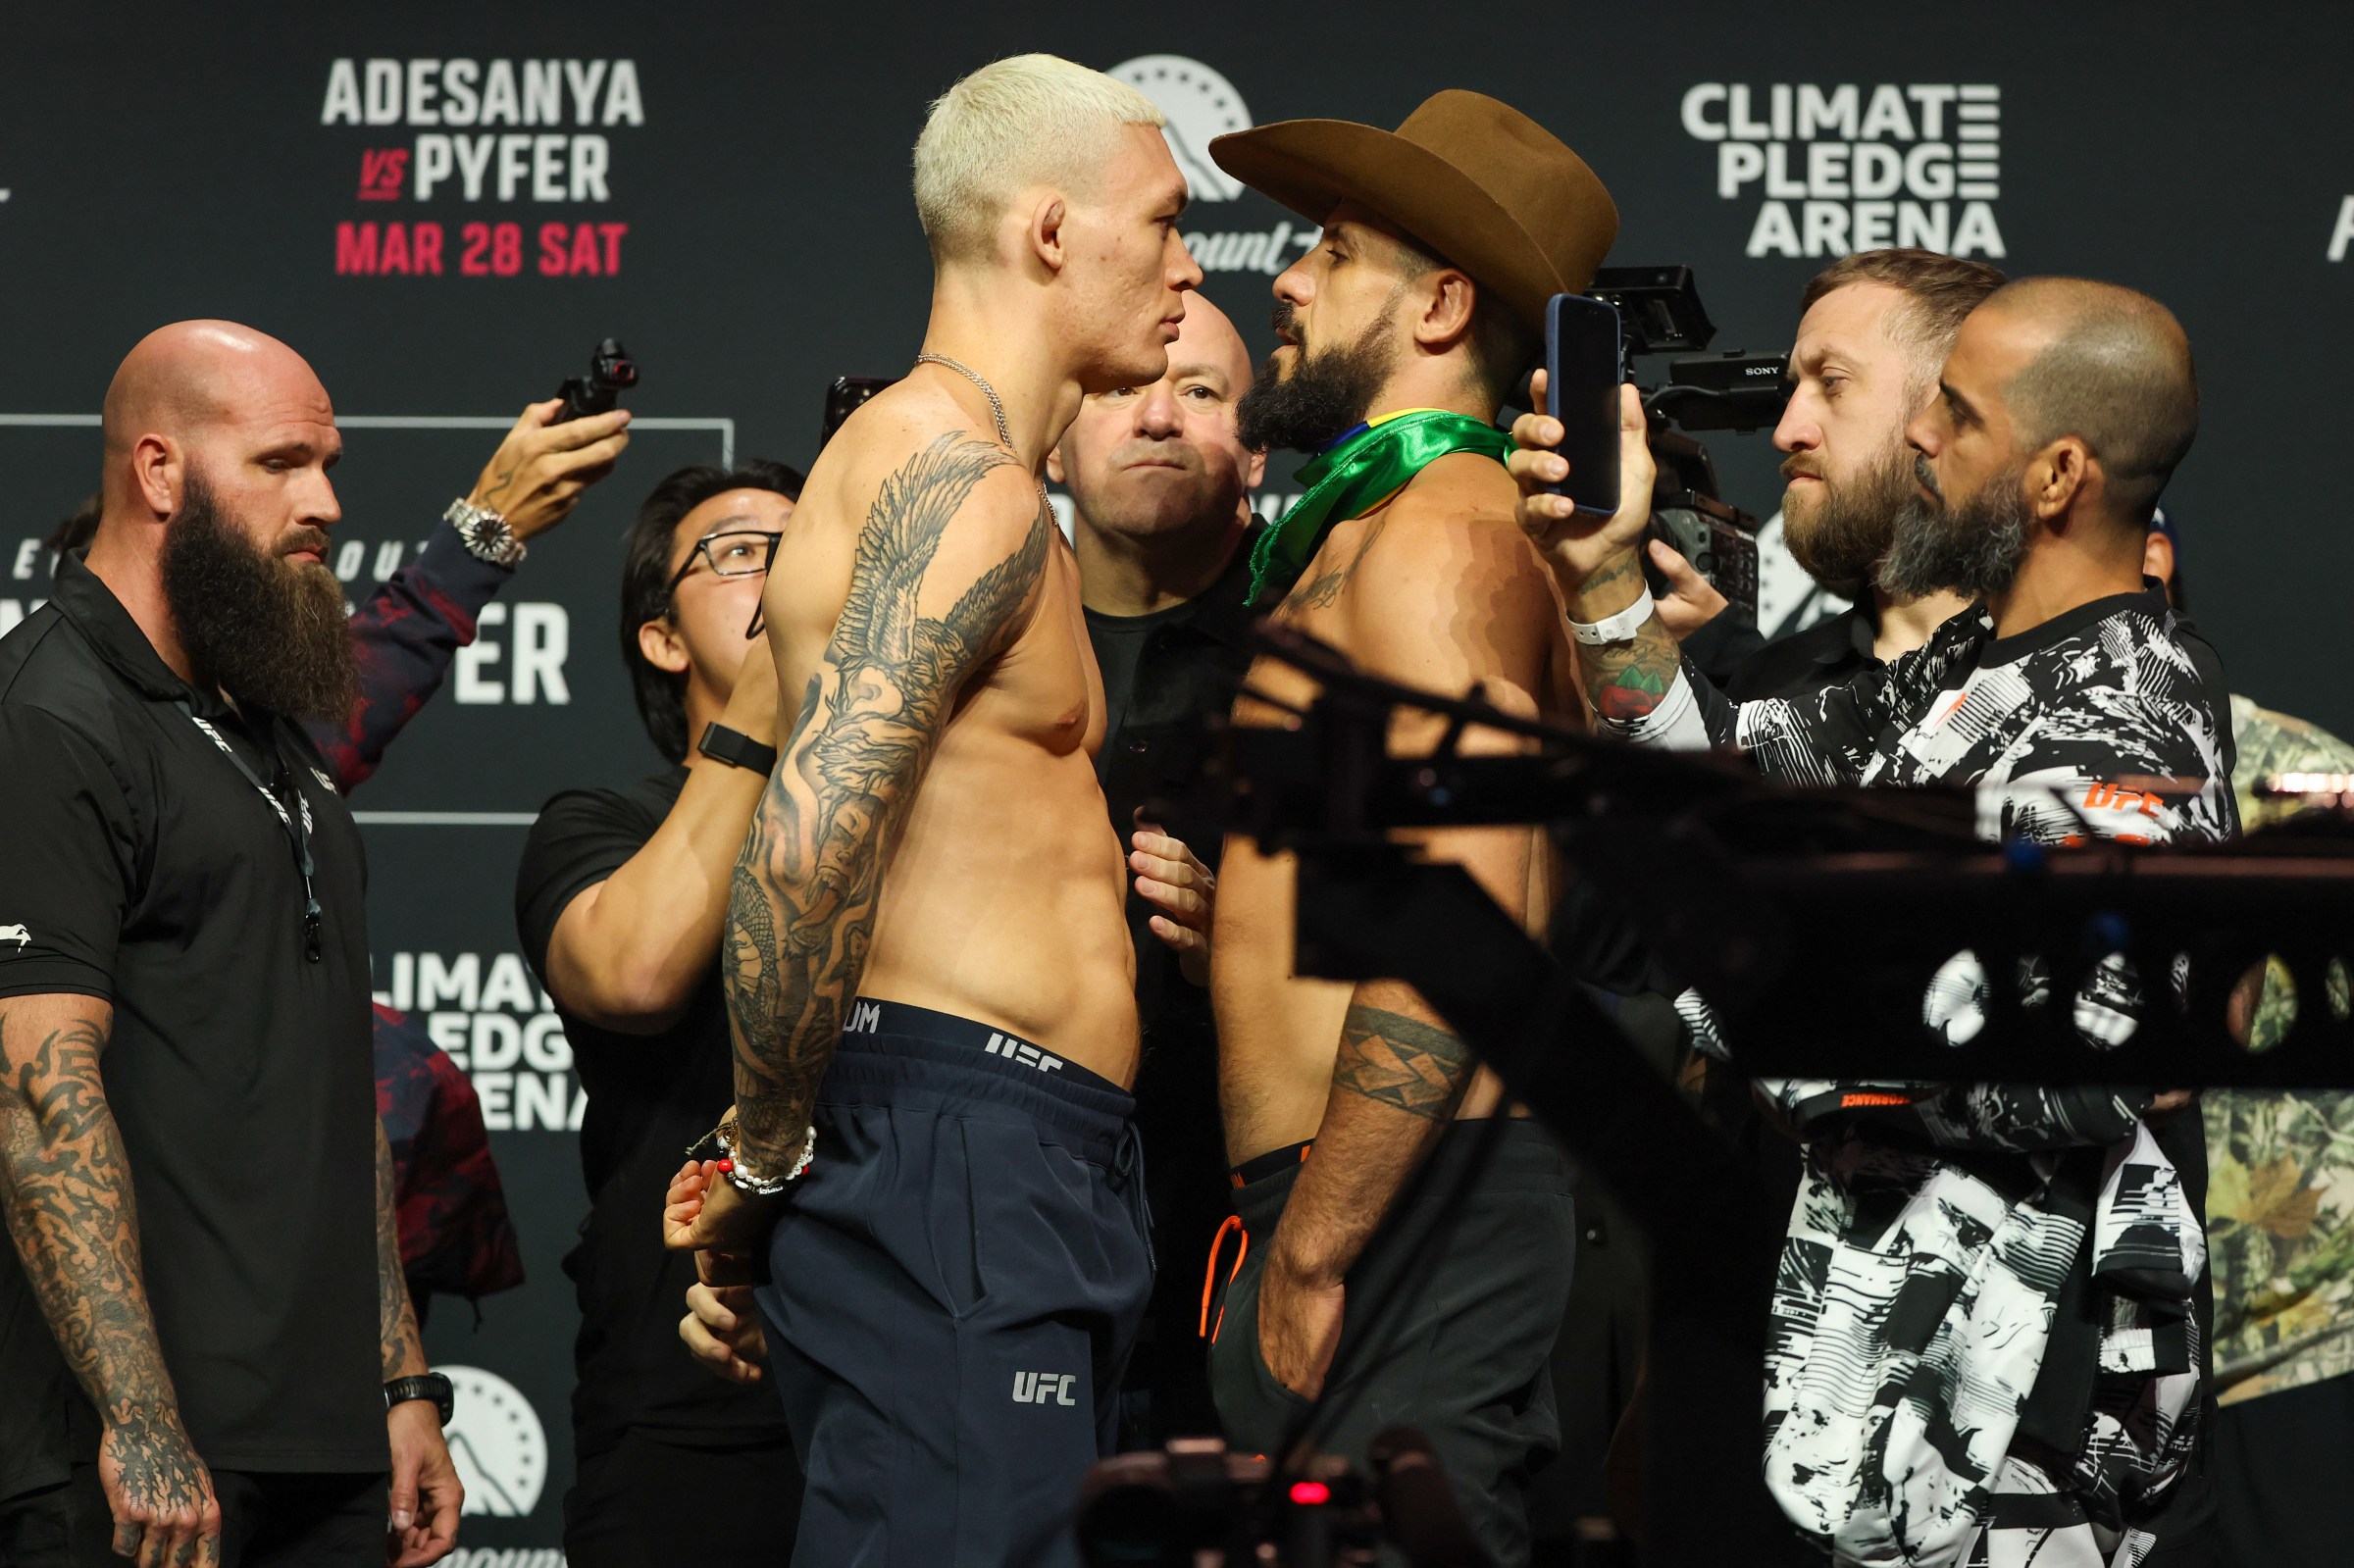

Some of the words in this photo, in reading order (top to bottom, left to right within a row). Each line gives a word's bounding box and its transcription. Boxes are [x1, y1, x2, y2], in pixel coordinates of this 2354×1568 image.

[321, 58, 644, 126] ADESANYA
[1680, 82, 2001, 141] CLIMATE
[359, 148, 410, 190] VS
[414, 133, 611, 202] PYFER
[1718, 142, 2001, 199] PLEDGE
[335, 222, 444, 276] MAR
[460, 222, 522, 277] 28
[538, 222, 629, 277] SAT
[1746, 200, 2007, 258] ARENA
[1745, 366, 1779, 376] SONY
[192, 717, 232, 752] UFC
[258, 786, 292, 825] UFC
[2083, 782, 2165, 818] UFC
[1012, 1371, 1076, 1406] UFC
